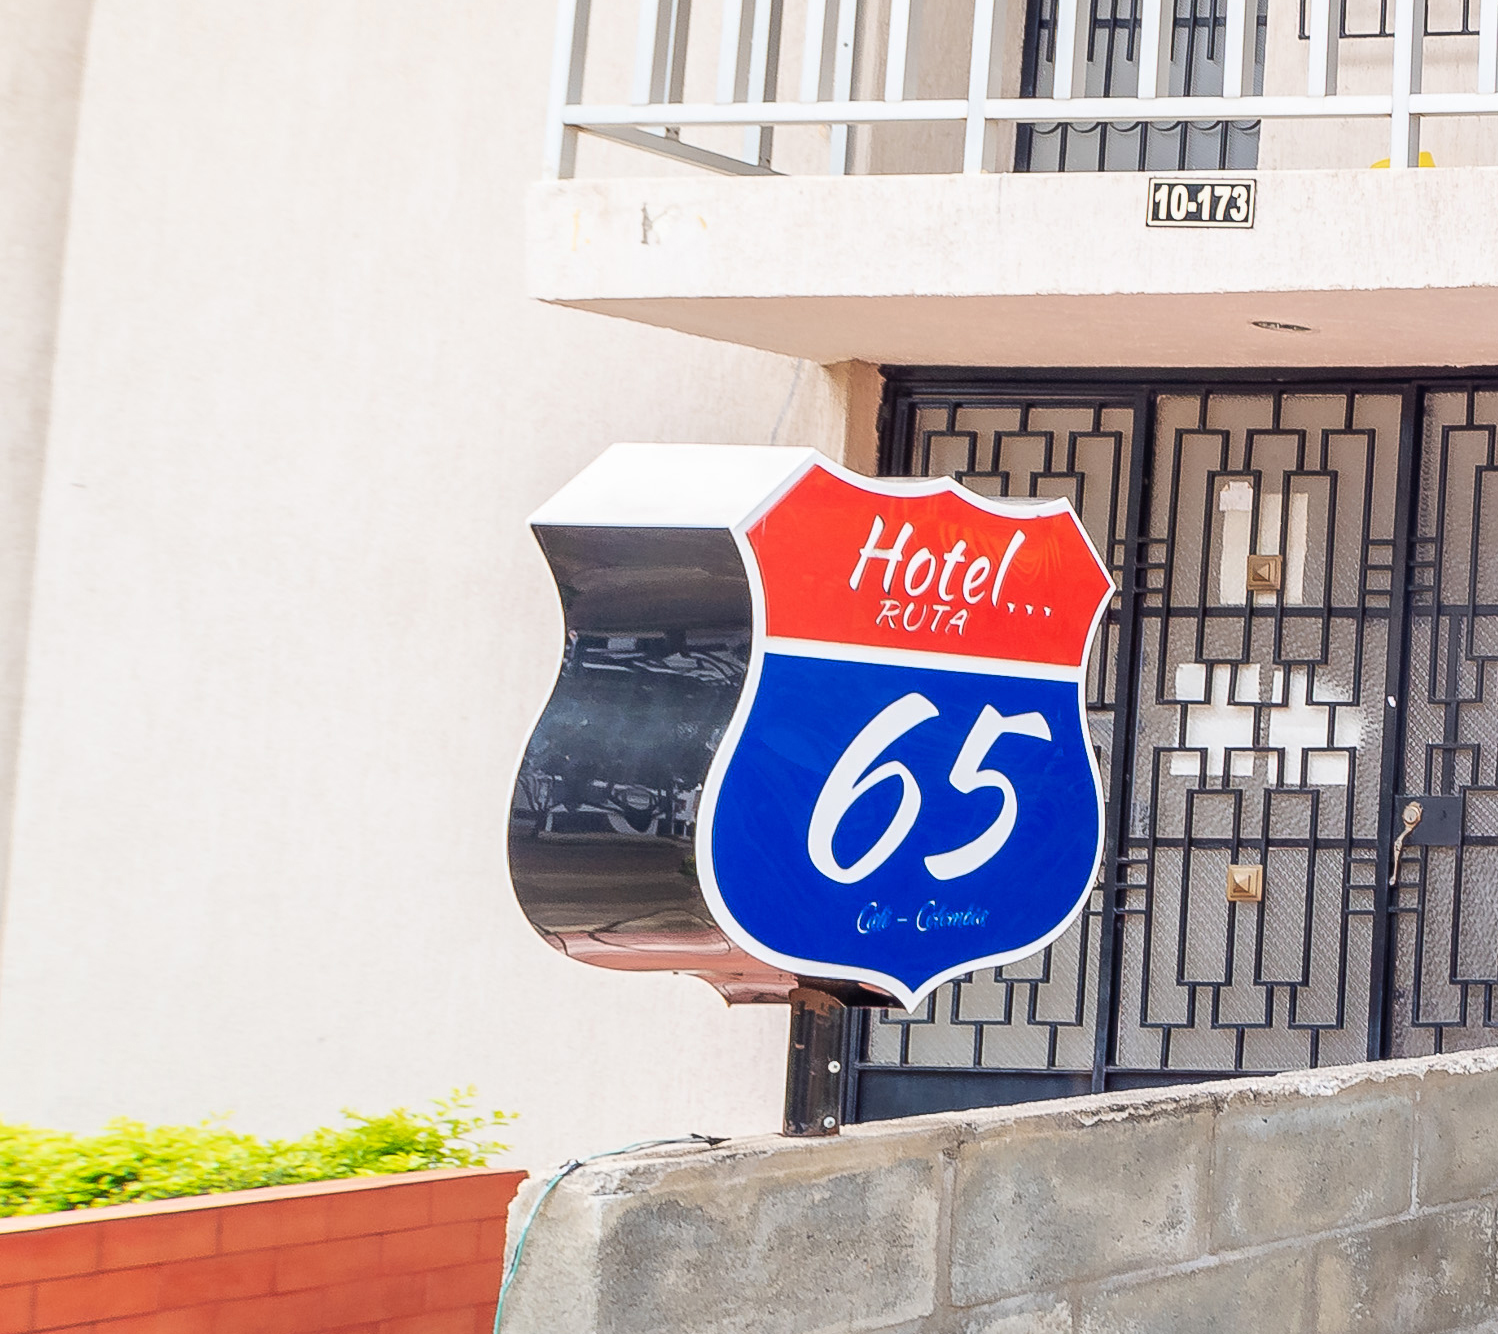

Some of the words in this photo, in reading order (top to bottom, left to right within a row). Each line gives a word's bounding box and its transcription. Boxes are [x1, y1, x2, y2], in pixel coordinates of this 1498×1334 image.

[1154, 184, 1249, 222] 10-173
[875, 598, 970, 635] RUTA
[807, 691, 1052, 884] 65
